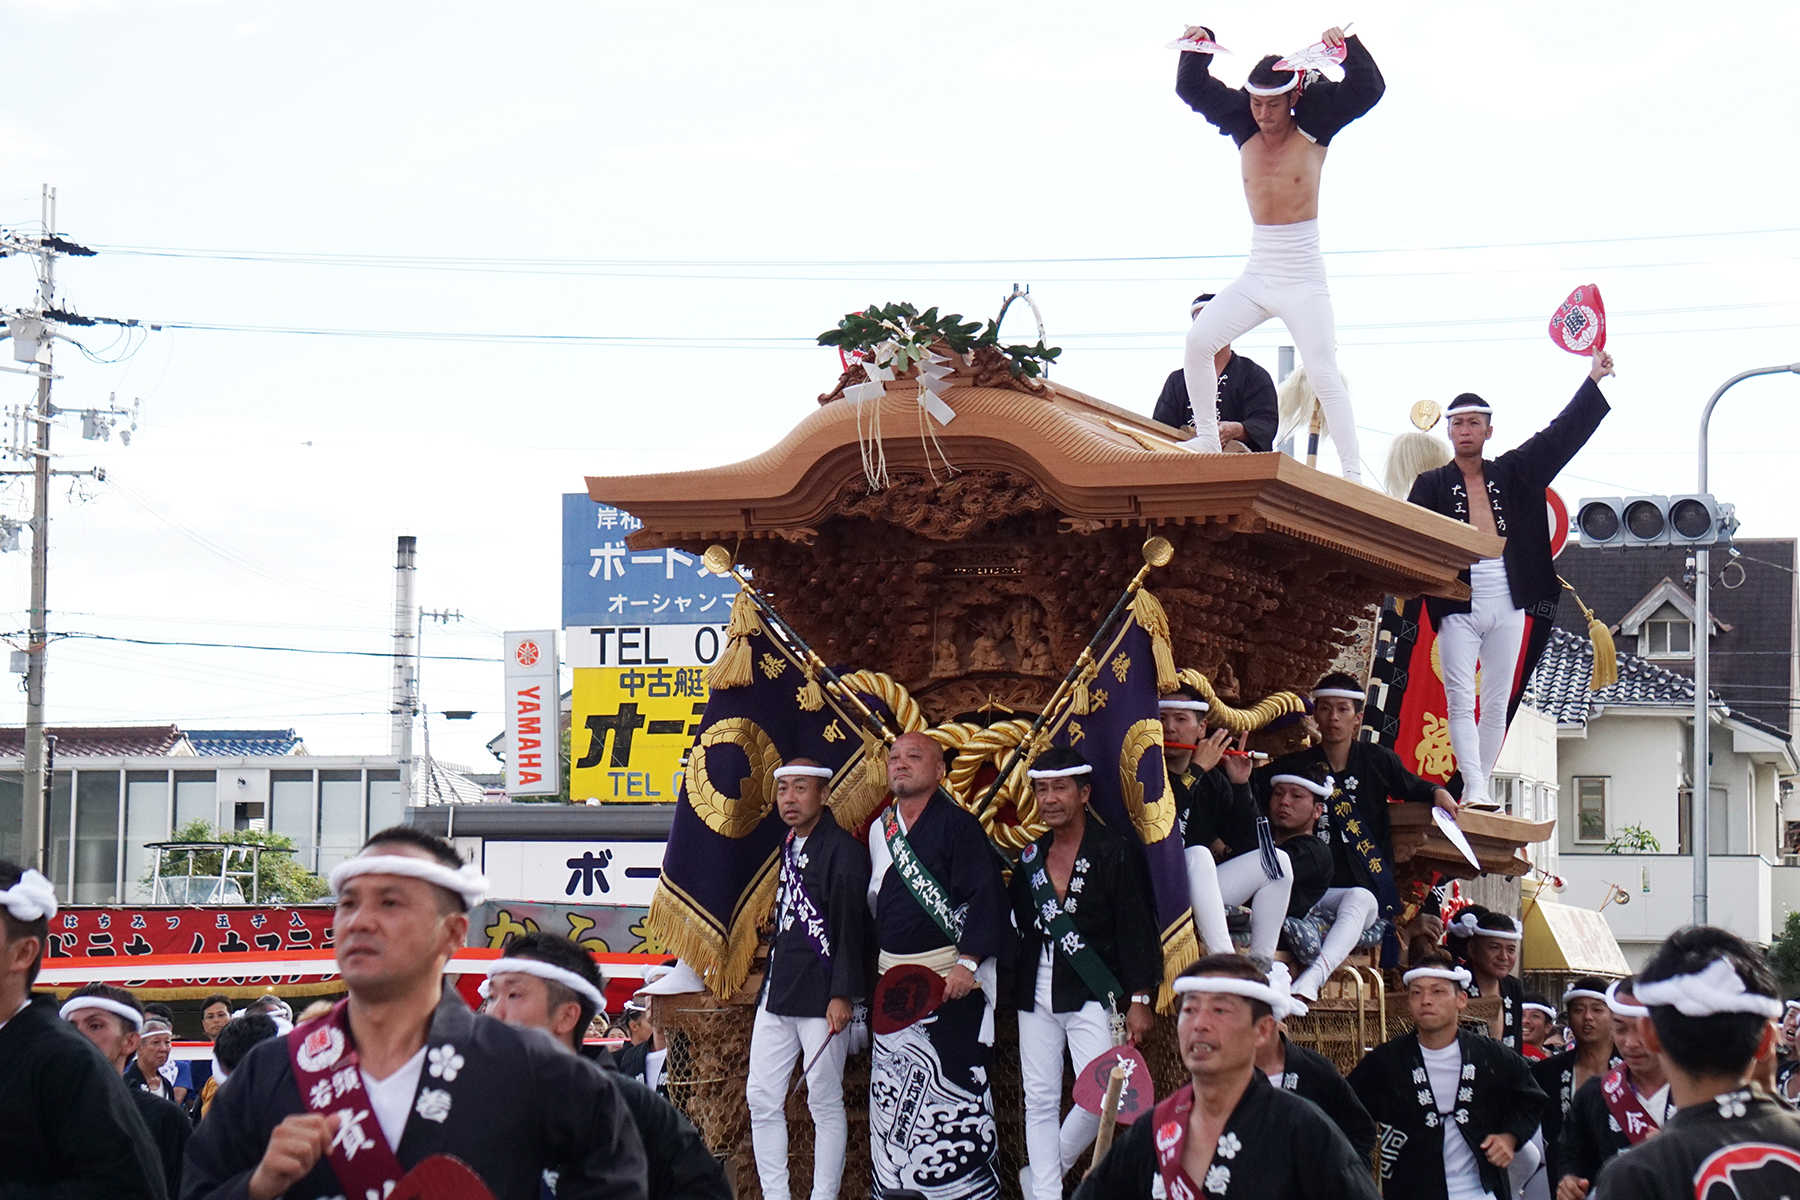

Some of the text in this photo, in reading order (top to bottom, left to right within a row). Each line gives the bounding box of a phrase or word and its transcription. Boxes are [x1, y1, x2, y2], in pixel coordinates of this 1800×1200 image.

[1451, 484, 1467, 523] 大工
[589, 541, 753, 581] ボート
[590, 625, 730, 666] TEL 0
[619, 668, 713, 698] 中古艇
[1067, 651, 1132, 747] 藤井町
[517, 684, 542, 787] YAMAHA
[607, 772, 660, 797] TEL
[565, 848, 662, 896] ボー
[63, 913, 181, 930] はちみつ
[1030, 867, 1086, 957] 相談役
